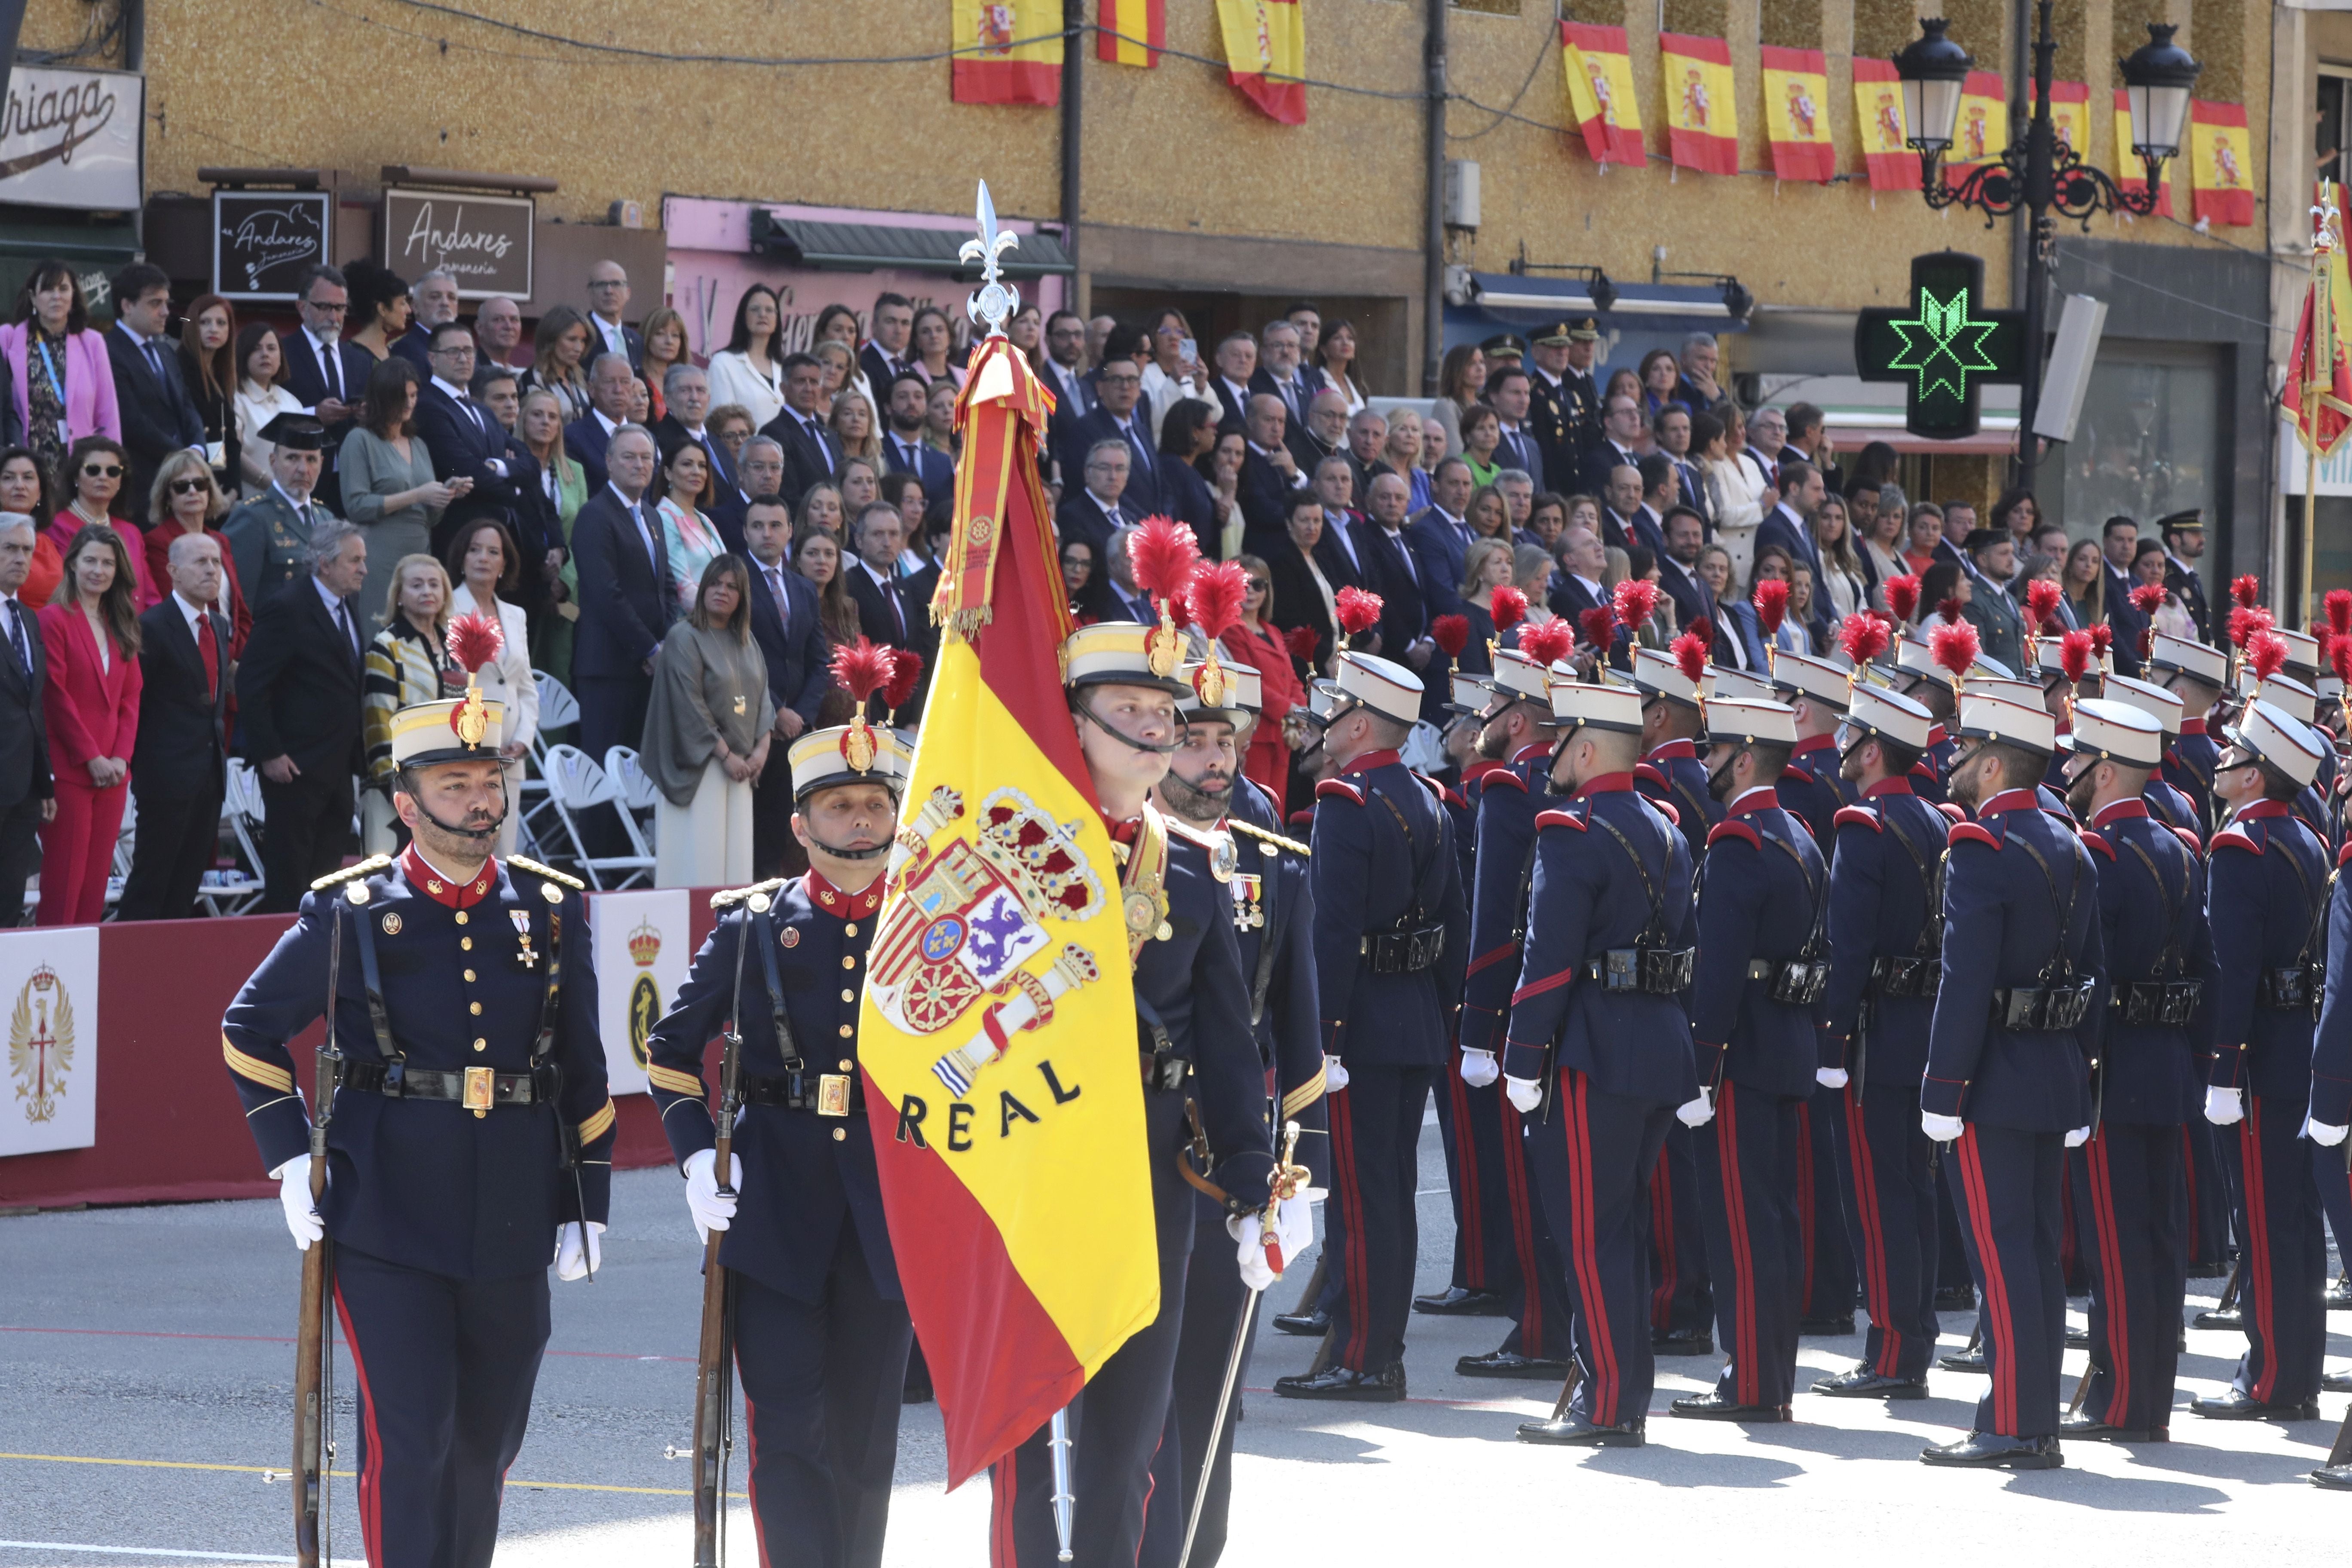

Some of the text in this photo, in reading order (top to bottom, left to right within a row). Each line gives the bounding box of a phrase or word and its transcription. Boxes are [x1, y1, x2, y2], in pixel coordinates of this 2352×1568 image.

[235, 220, 312, 251] Andares
[404, 200, 514, 263] Andares
[2321, 440, 2352, 483] VIT
[894, 1060, 1081, 1152] REAL
